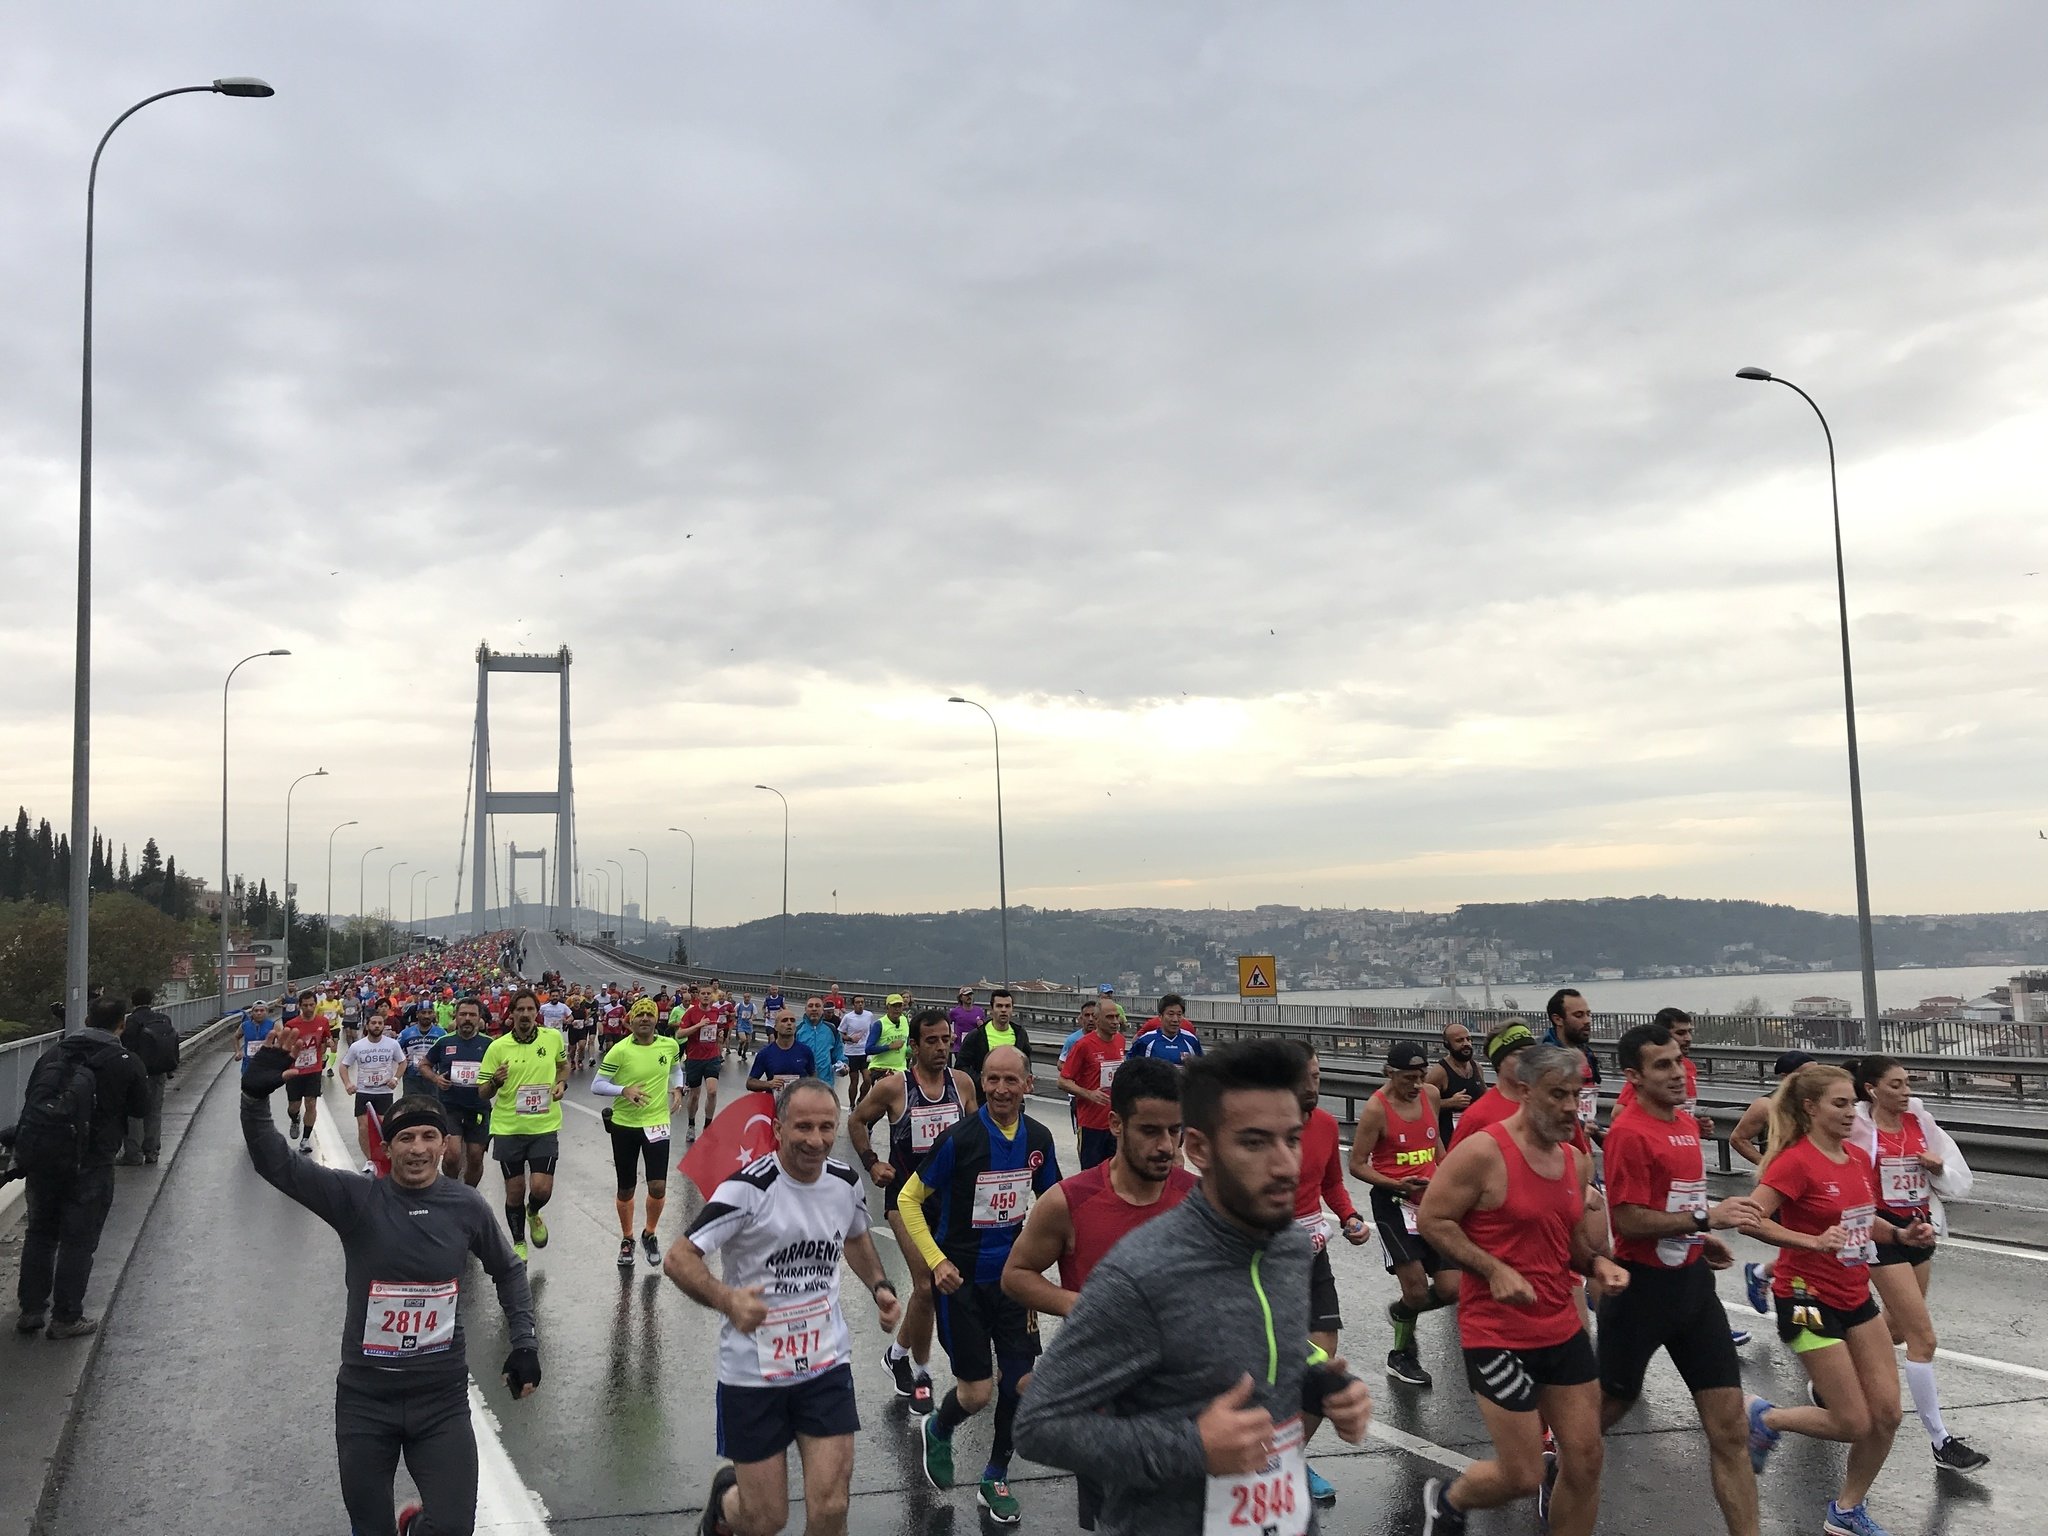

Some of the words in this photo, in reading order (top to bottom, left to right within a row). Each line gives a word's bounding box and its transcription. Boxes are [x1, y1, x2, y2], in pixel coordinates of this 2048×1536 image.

[457, 1070, 475, 1079] 1989
[526, 1095, 542, 1106] 693
[1396, 1147, 1436, 1166] PERU
[989, 1191, 1017, 1210] 459
[381, 1309, 439, 1334] 2814
[772, 1329, 820, 1361] 2477
